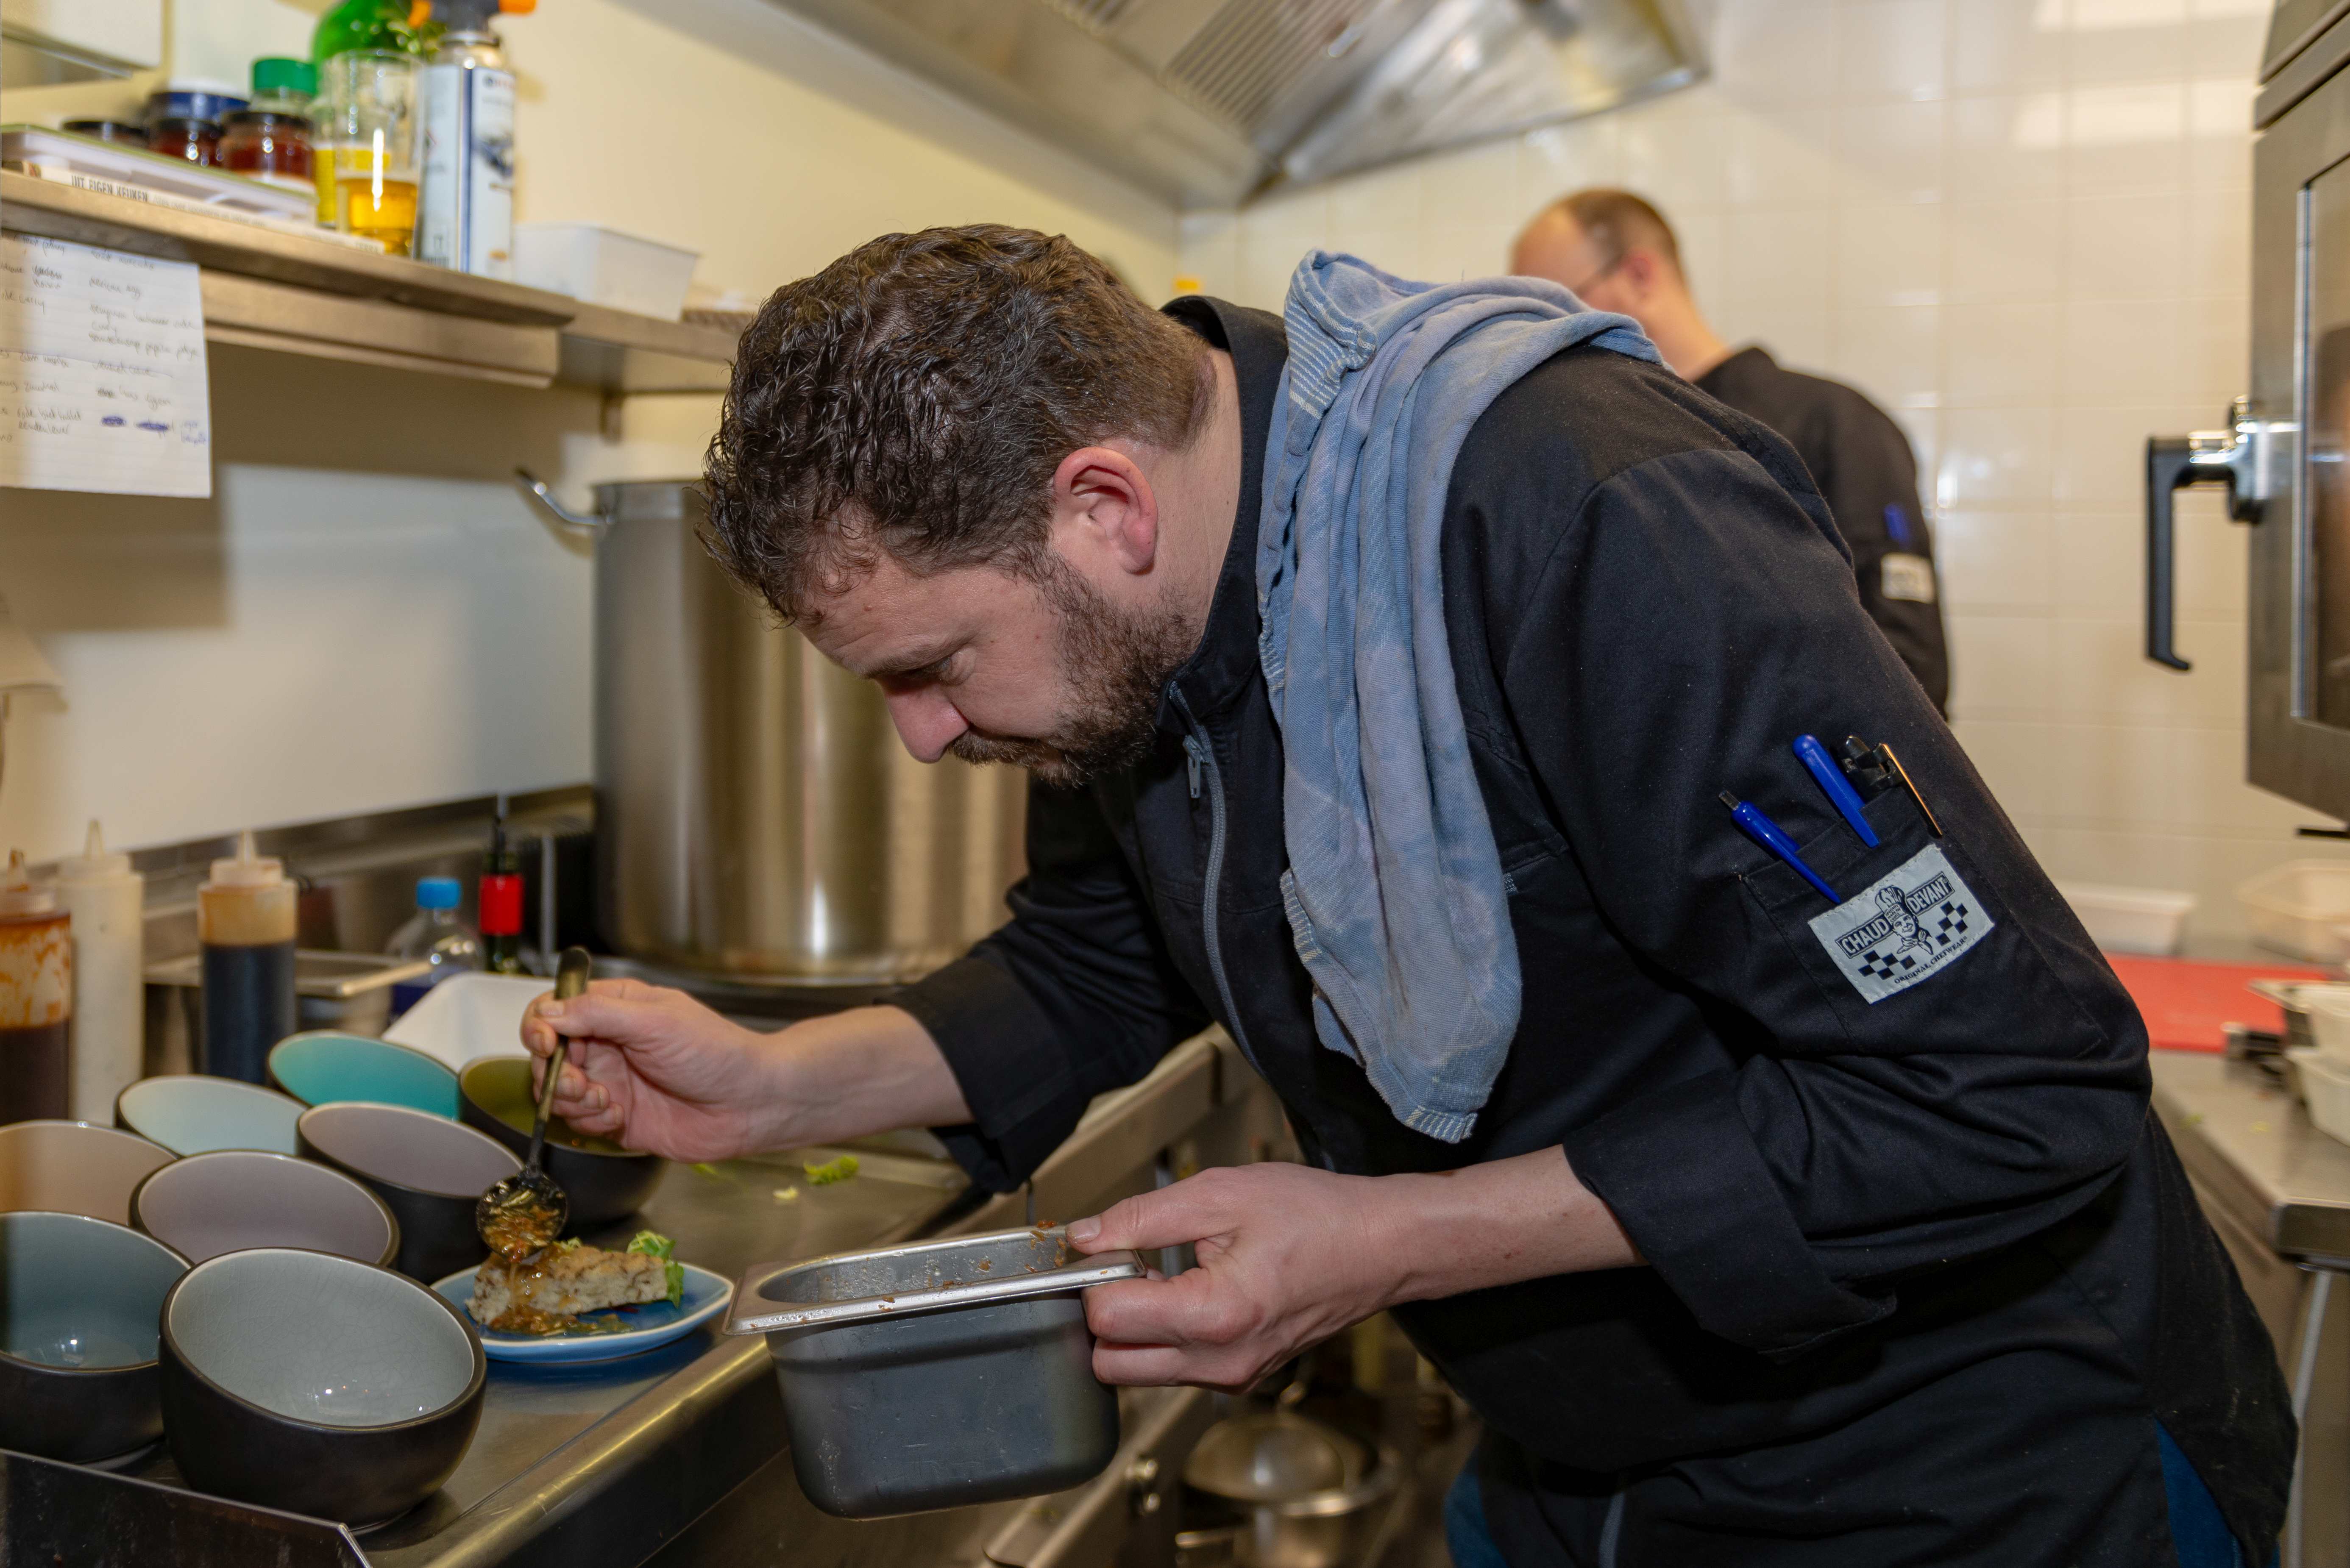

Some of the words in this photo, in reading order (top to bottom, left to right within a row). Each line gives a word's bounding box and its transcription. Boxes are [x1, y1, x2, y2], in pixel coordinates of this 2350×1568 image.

[88, 179, 113, 195] EIGEN
[116, 185, 148, 202] KEUKEN
[1841, 917, 1890, 954] CHAUD
[1894, 963, 1931, 984] ORIGINAL
